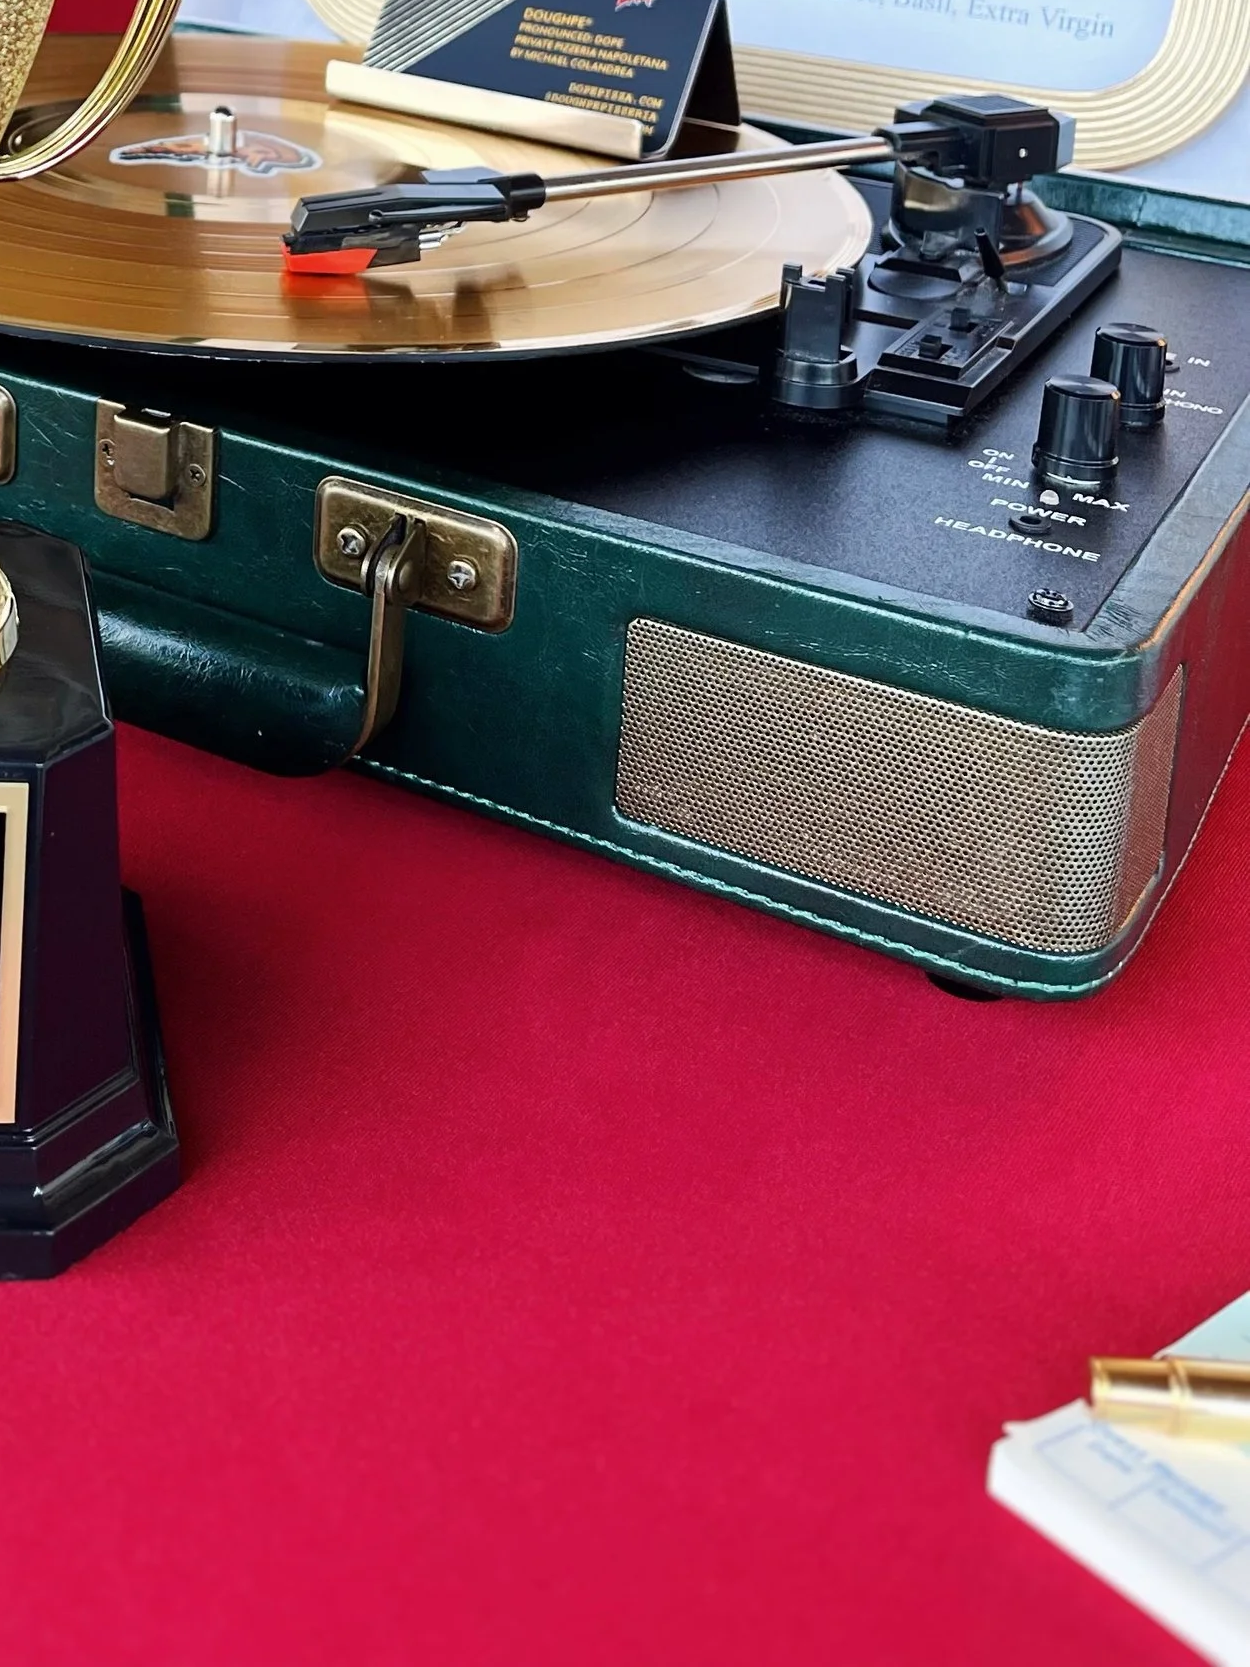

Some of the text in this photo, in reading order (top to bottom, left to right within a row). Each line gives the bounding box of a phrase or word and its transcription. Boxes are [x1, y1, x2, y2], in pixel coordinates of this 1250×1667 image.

[1039, 5, 1114, 41] Virgin
[514, 34, 669, 71] PRIVATE PIZZERIA NAPOLETANA
[594, 34, 625, 49] DOPE
[510, 47, 635, 78] BY MICHAEL COLANDREA
[1187, 356, 1211, 367] IN
[1156, 398, 1224, 415] HONO
[967, 460, 1011, 473] OFF
[982, 448, 1015, 461] ON
[981, 472, 1130, 513] MIN MAX
[990, 497, 1087, 528] POWER
[935, 516, 1101, 563] HEADPHONE
